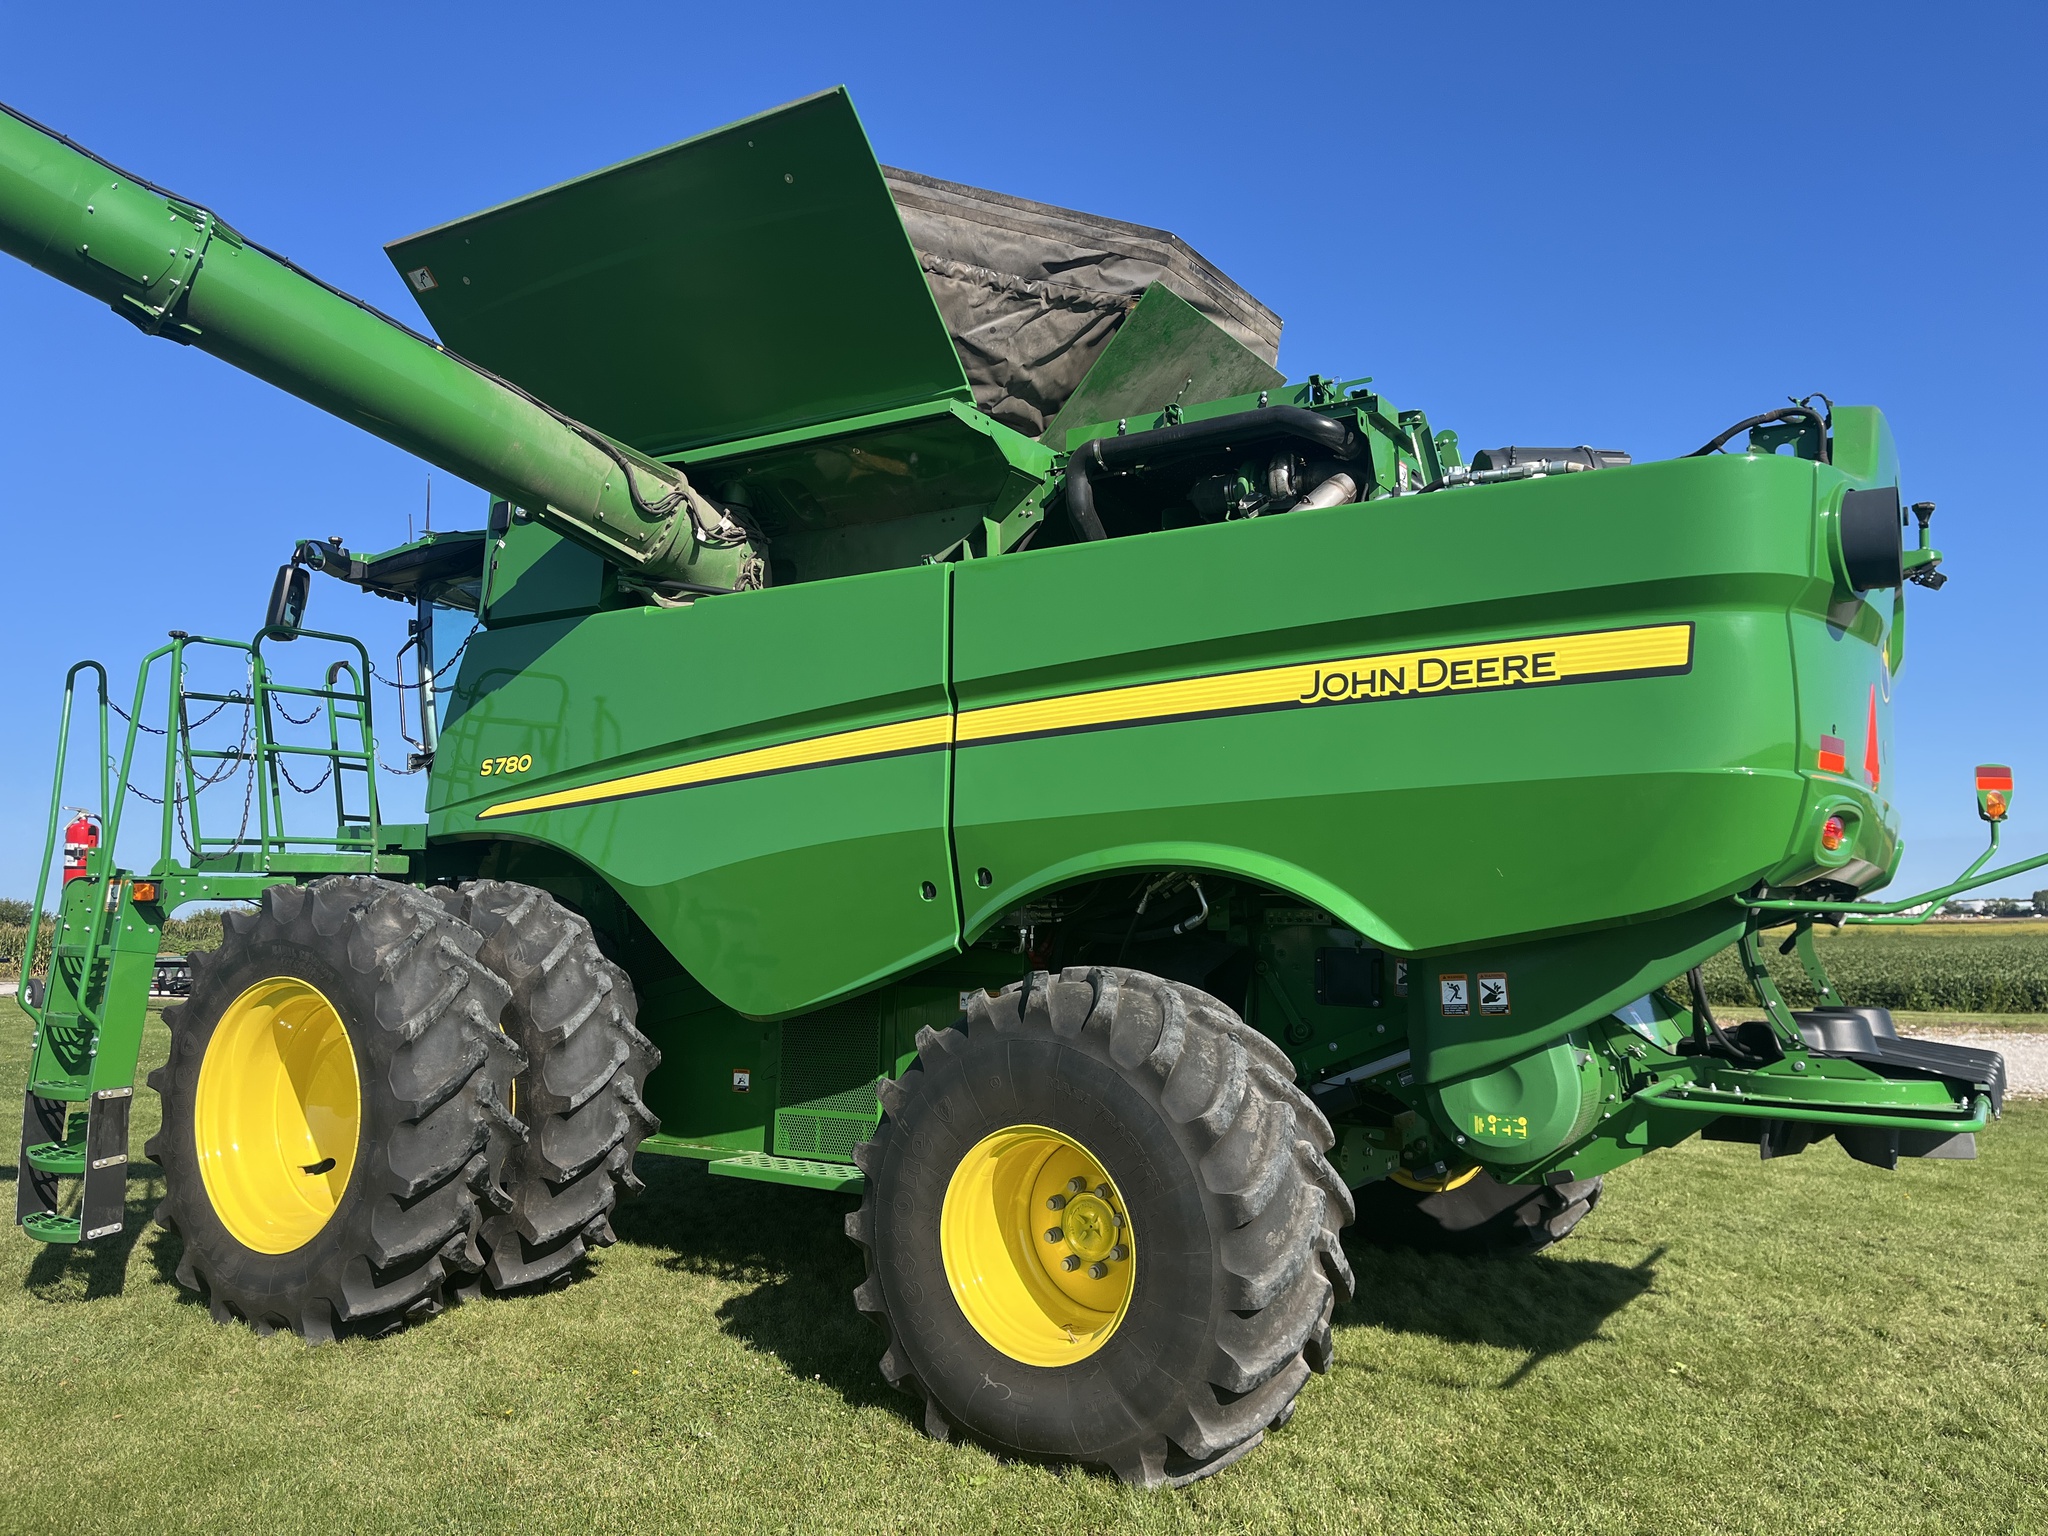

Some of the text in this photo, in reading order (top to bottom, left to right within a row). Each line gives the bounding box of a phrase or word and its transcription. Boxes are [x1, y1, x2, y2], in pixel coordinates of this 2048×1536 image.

[1300, 651, 1557, 701] JOHN DEERE
[480, 753, 533, 777] S780
[892, 1130, 962, 1379] Firestone
